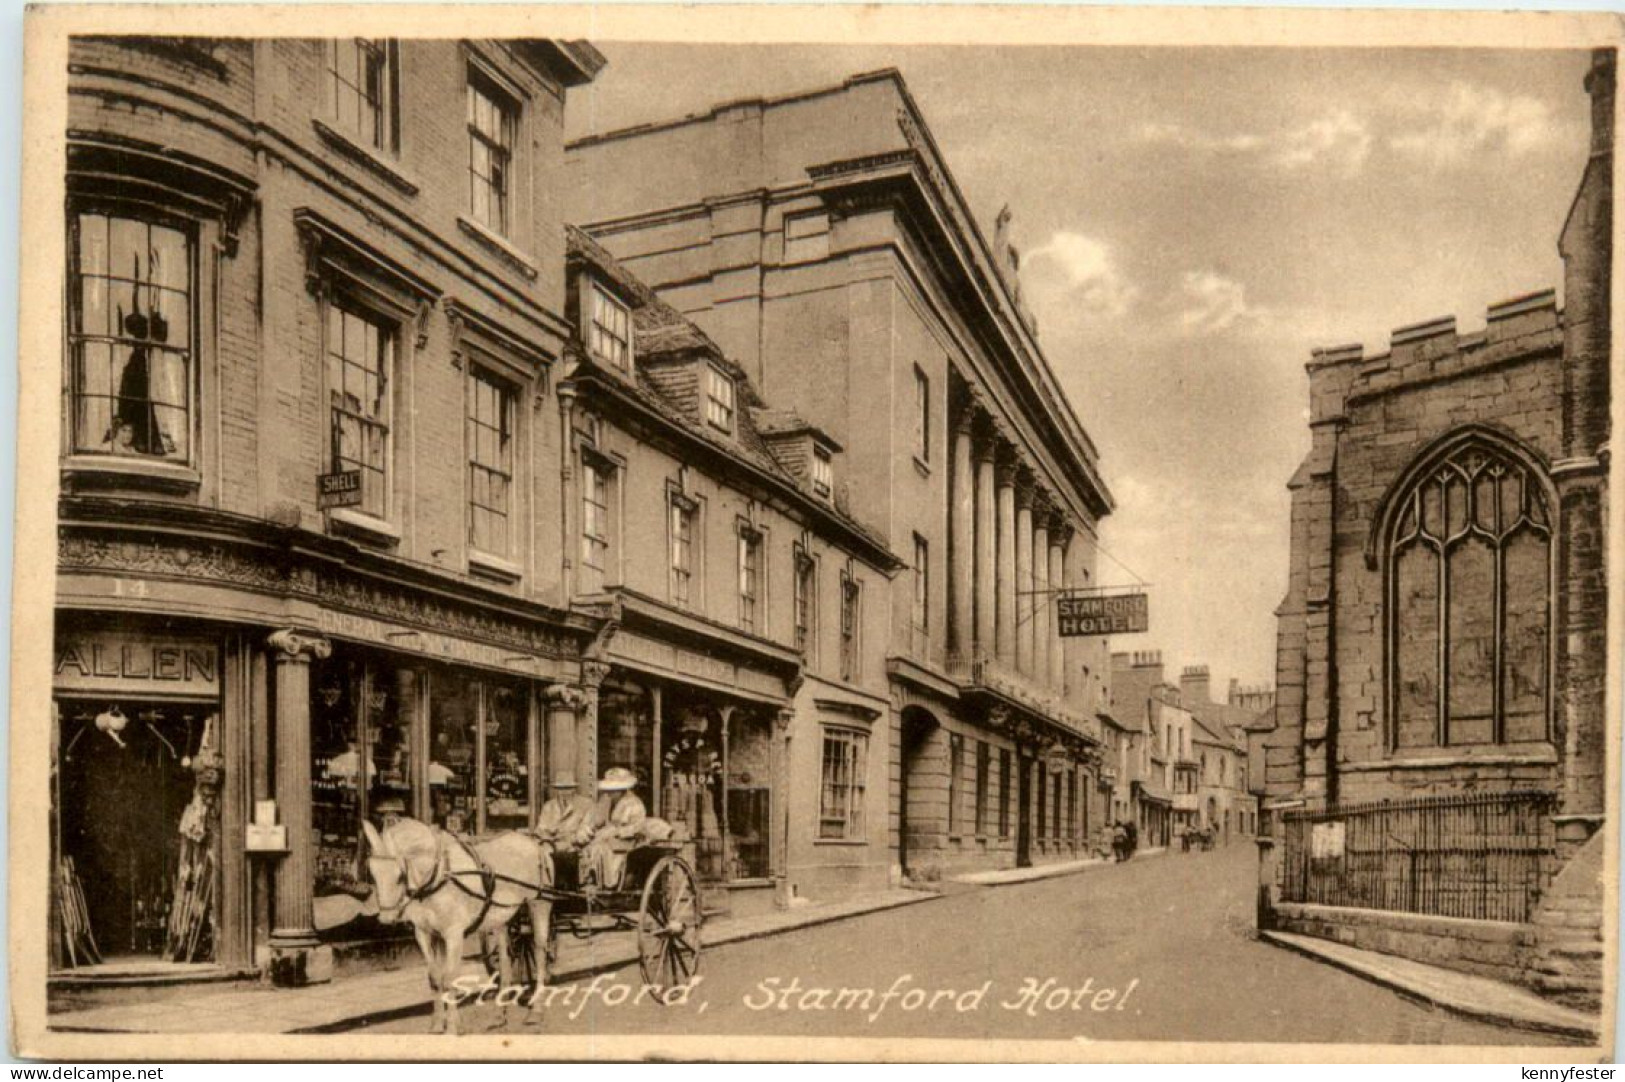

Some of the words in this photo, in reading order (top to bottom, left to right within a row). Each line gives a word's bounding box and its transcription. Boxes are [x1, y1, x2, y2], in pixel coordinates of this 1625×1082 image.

[324, 474, 357, 492] SHELL
[1060, 598, 1145, 617] STAMFORD
[1062, 615, 1140, 634] HOTEL
[53, 643, 215, 682] ALLEN
